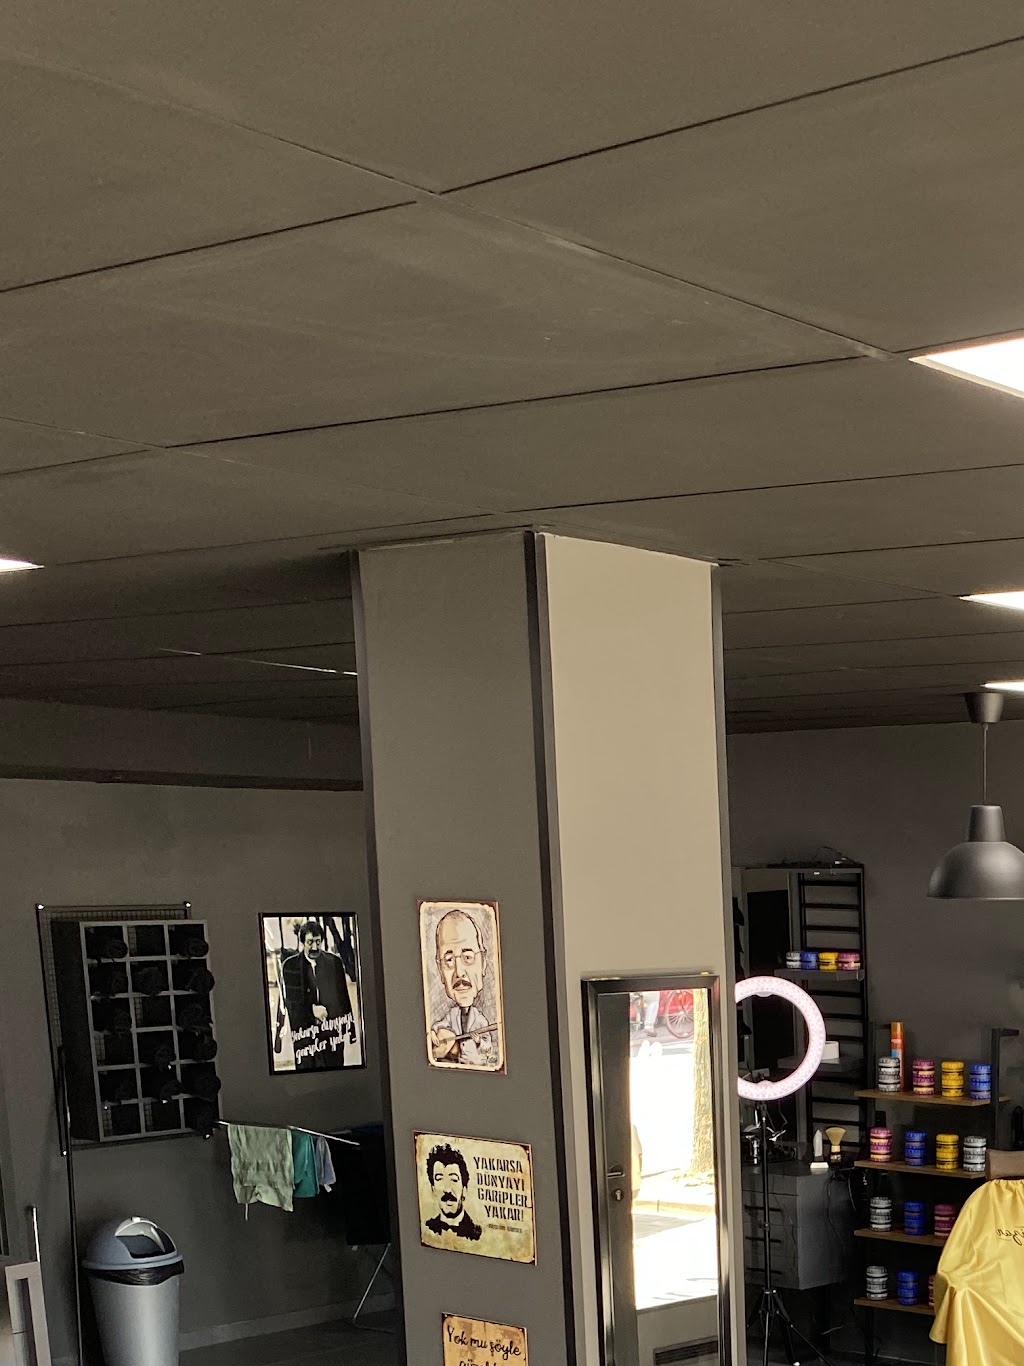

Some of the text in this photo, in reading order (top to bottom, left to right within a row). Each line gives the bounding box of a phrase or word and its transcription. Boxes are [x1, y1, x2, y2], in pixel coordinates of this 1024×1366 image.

[473, 1156, 524, 1174] YAKARSA
[477, 1172, 525, 1191] DÜNYAYI
[484, 1205, 524, 1222] YAKAR!
[446, 1324, 521, 1360] Yok mu şöyle
